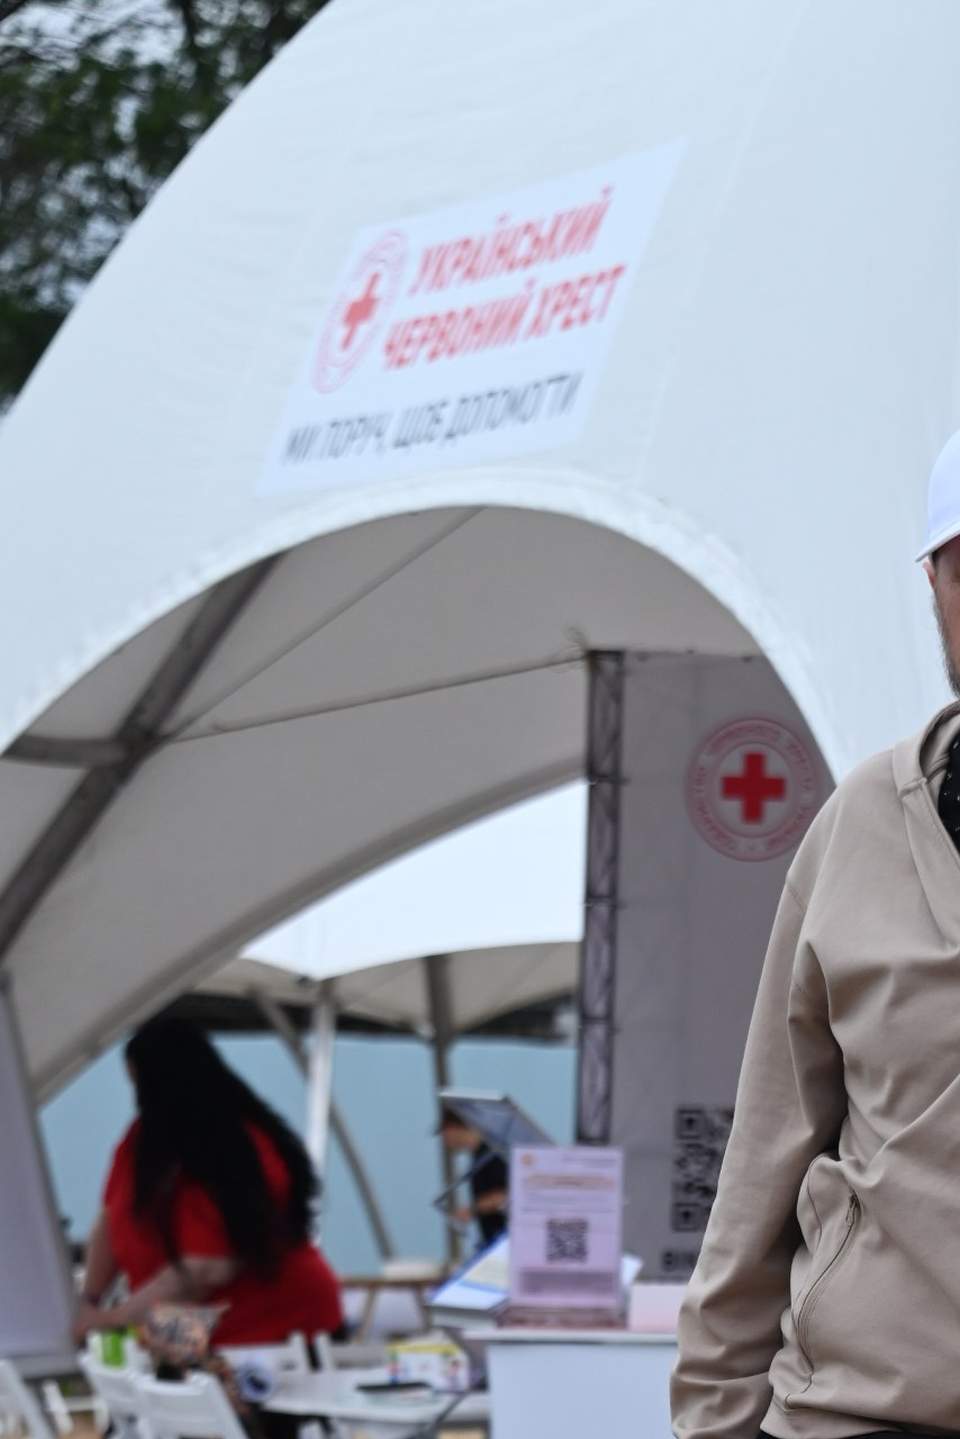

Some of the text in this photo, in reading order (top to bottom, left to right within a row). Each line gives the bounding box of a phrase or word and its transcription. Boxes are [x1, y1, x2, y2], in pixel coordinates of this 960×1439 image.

[407, 184, 615, 297] УКРАЇНСЬКИЙ
[383, 264, 627, 370] ЧЕРВОНИЙ ХРЕСТ
